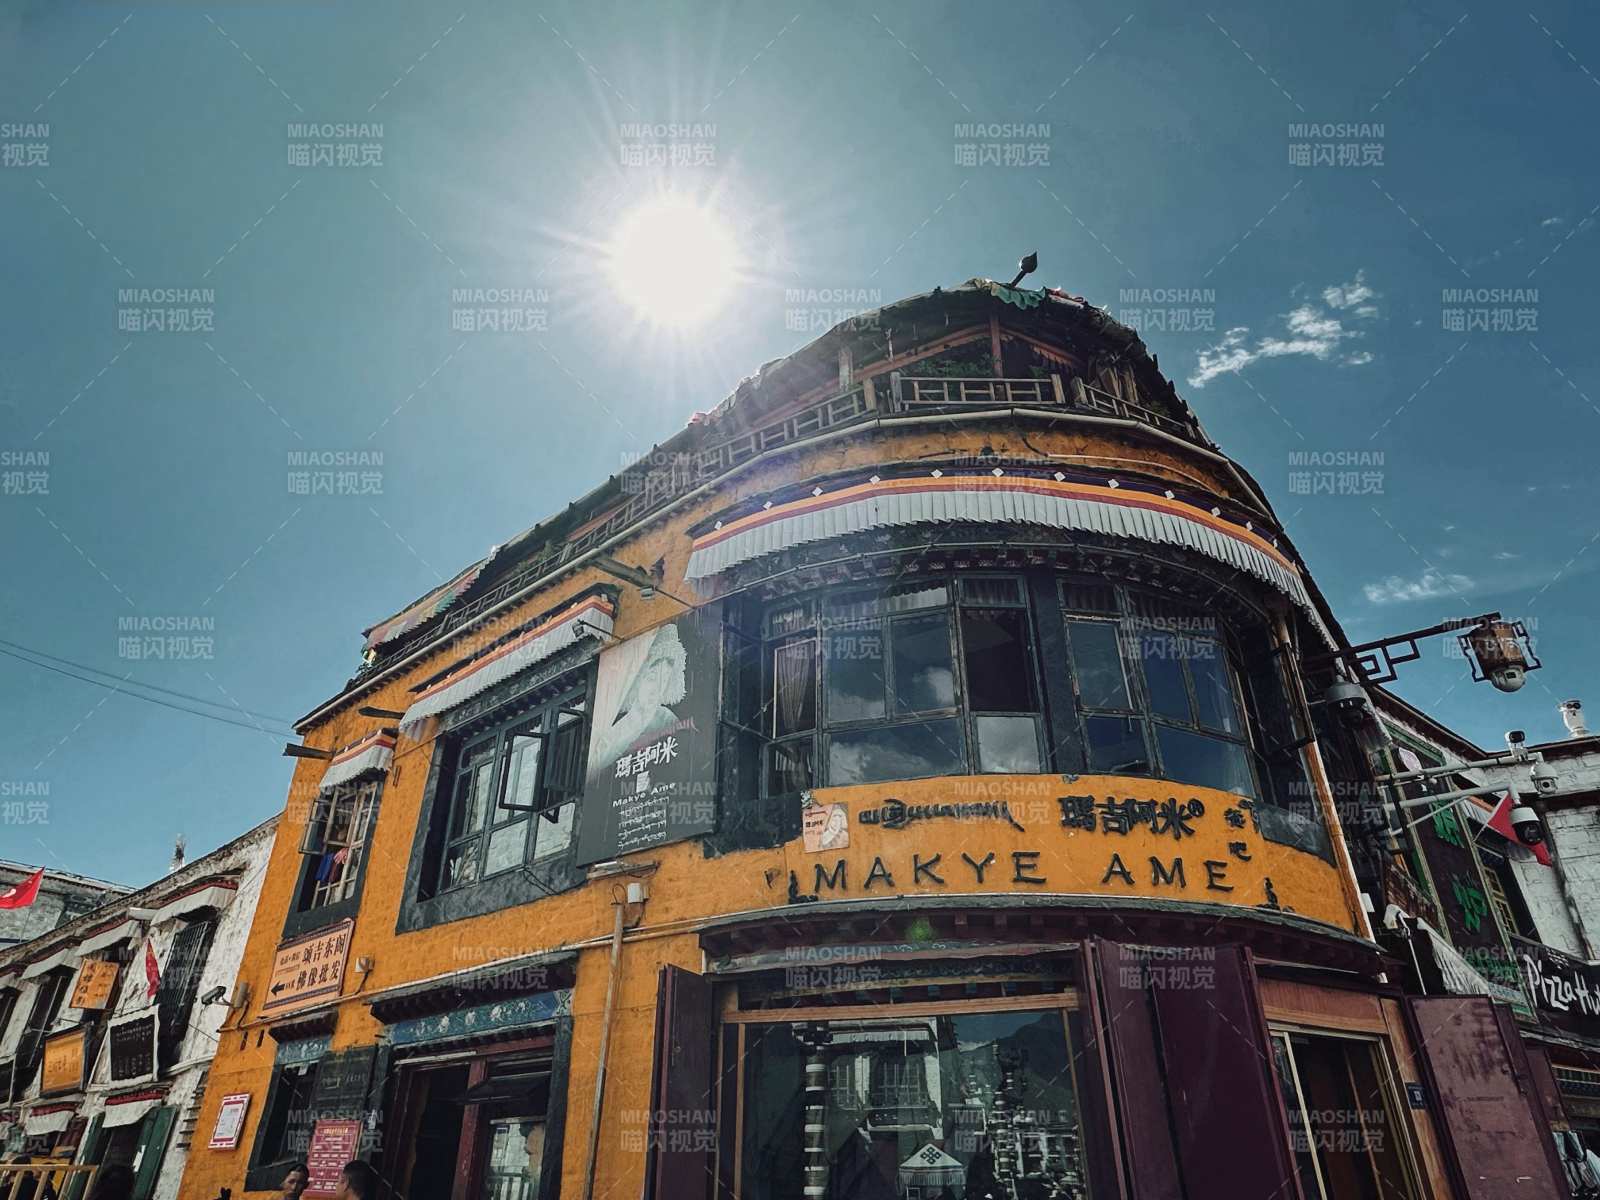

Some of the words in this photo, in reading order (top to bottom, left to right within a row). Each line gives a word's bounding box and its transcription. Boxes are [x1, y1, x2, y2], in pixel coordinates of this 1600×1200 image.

[612, 792, 646, 808] Makye
[650, 782, 677, 796] Ame
[814, 850, 1047, 892] MAKYE
[1101, 852, 1235, 892] AME
[1523, 953, 1578, 1012] Pizza
